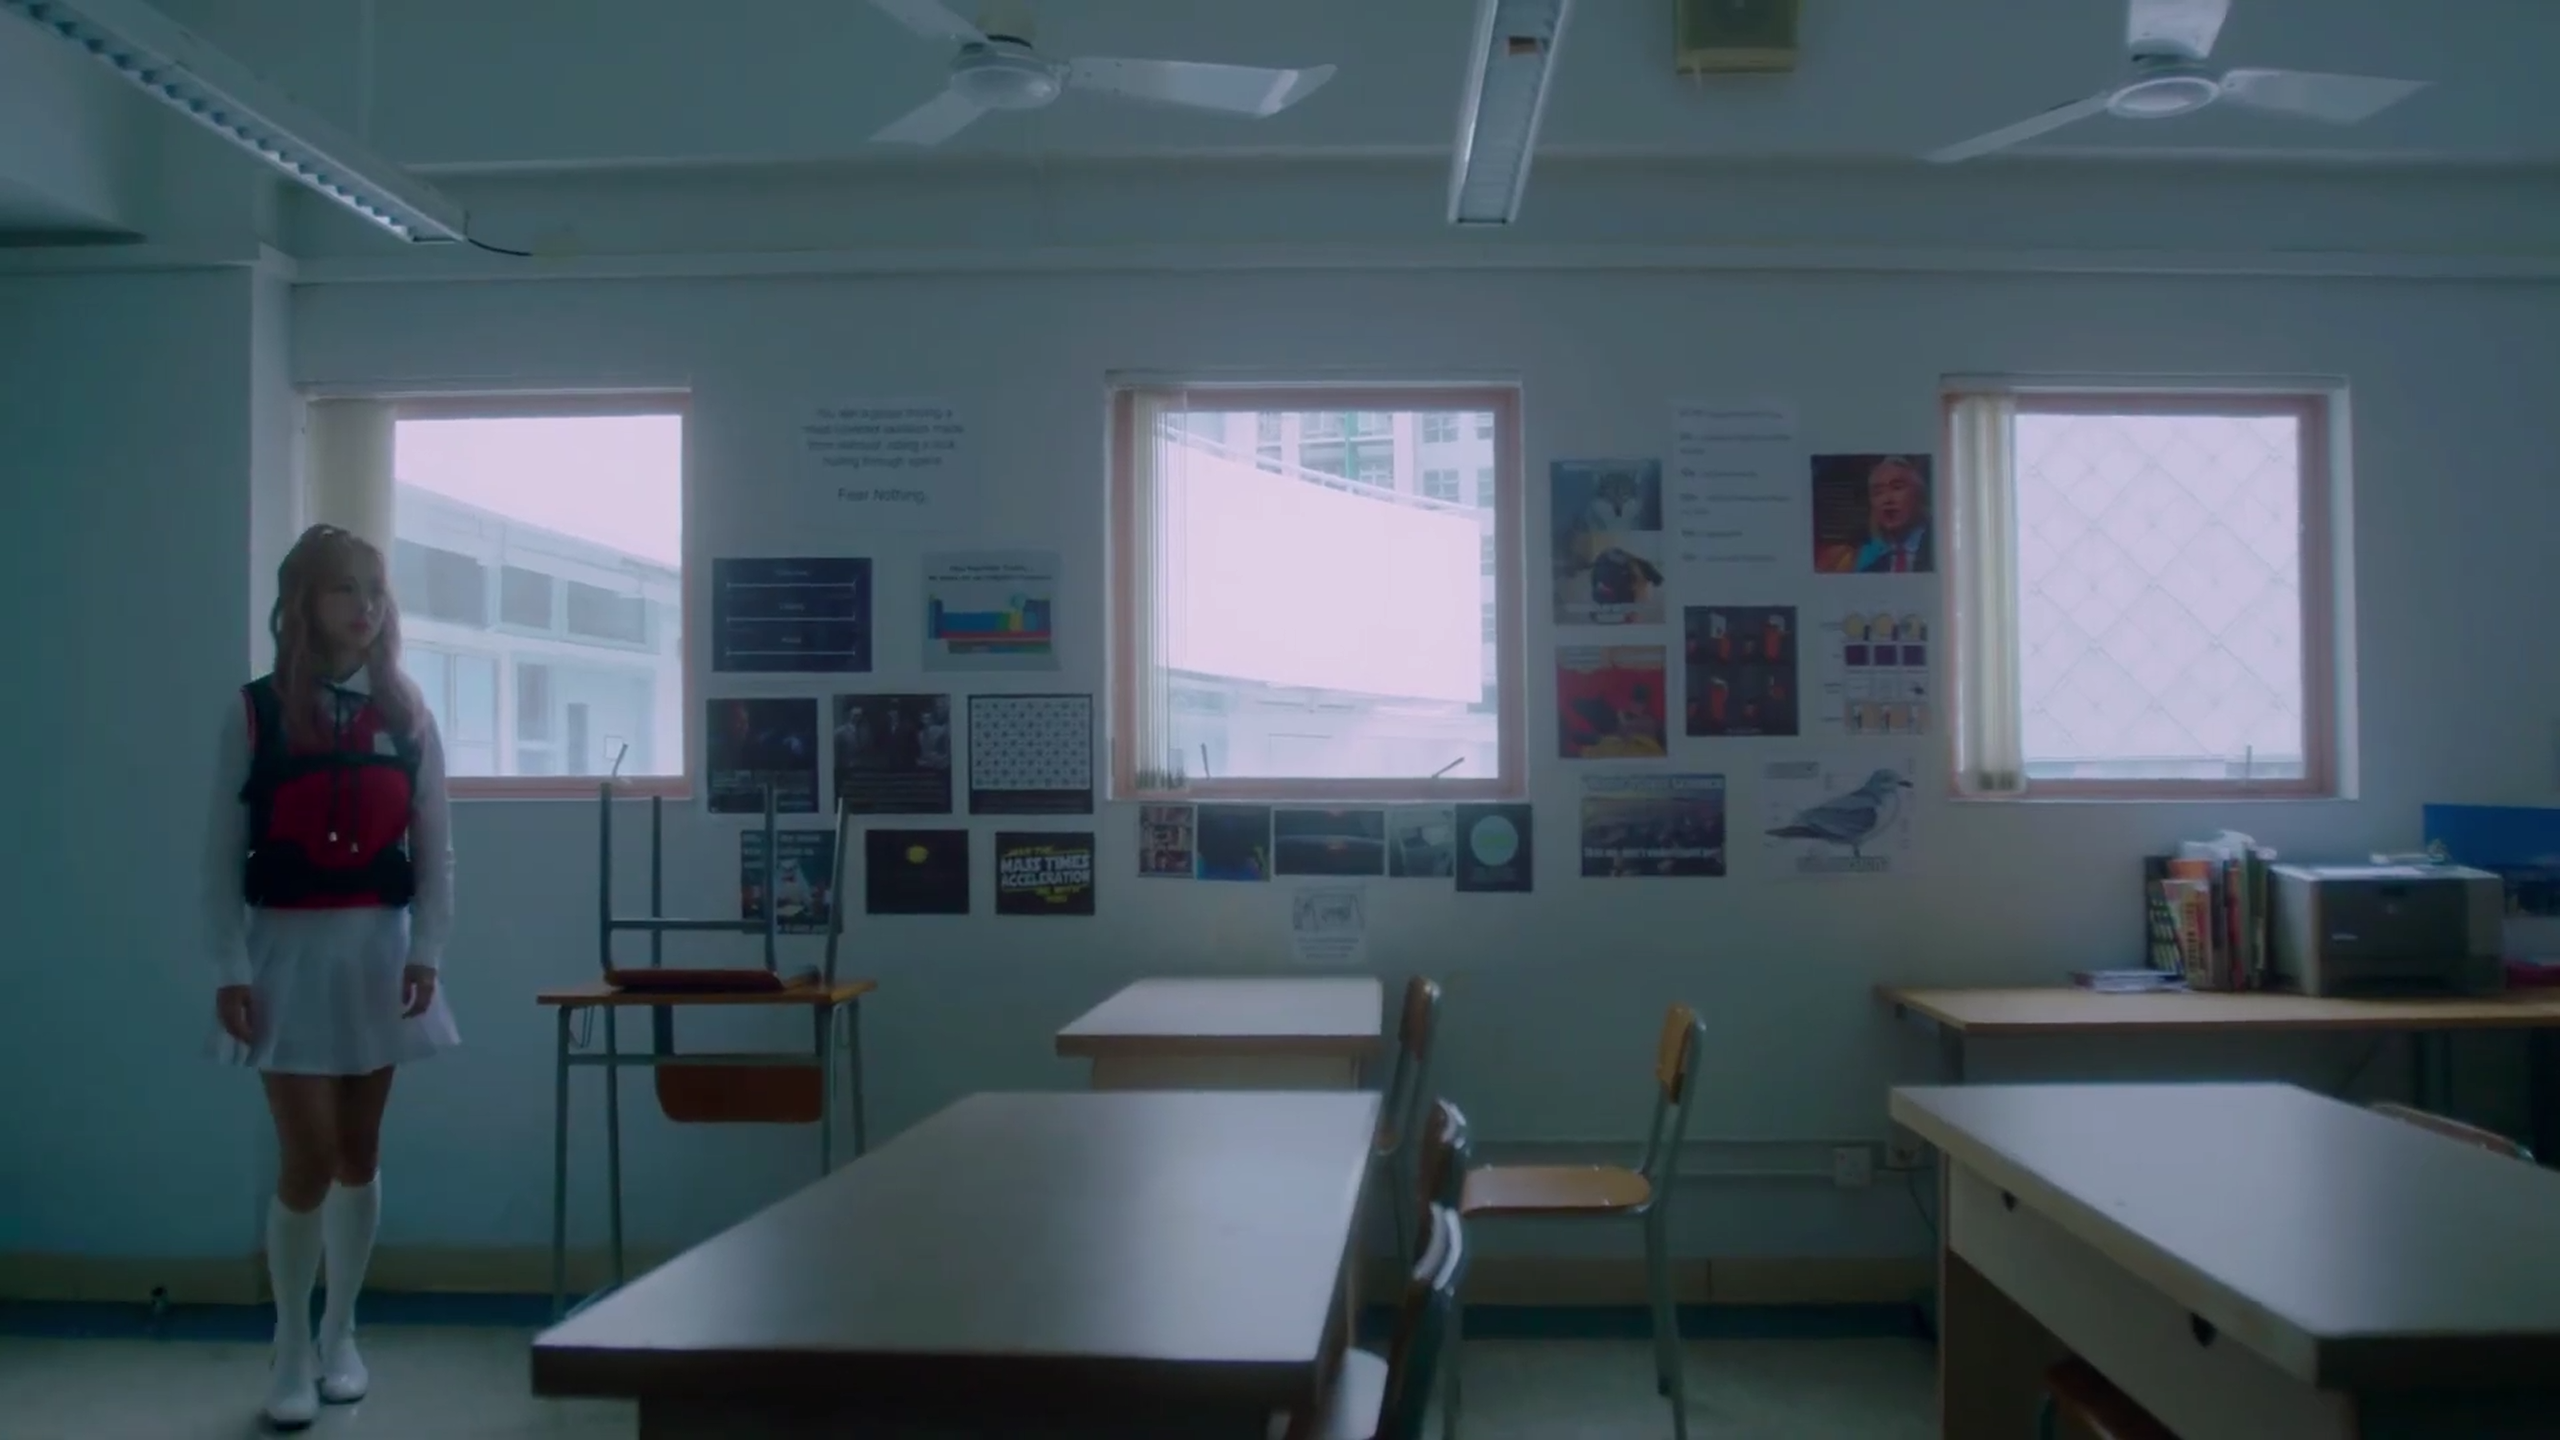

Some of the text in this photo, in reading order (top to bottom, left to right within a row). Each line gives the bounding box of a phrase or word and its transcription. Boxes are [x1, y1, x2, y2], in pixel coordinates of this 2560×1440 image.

[838, 487, 869, 502] Fear
[1001, 855, 1091, 873] MASS TIMES
[1001, 870, 1092, 888] ACCELERATION
